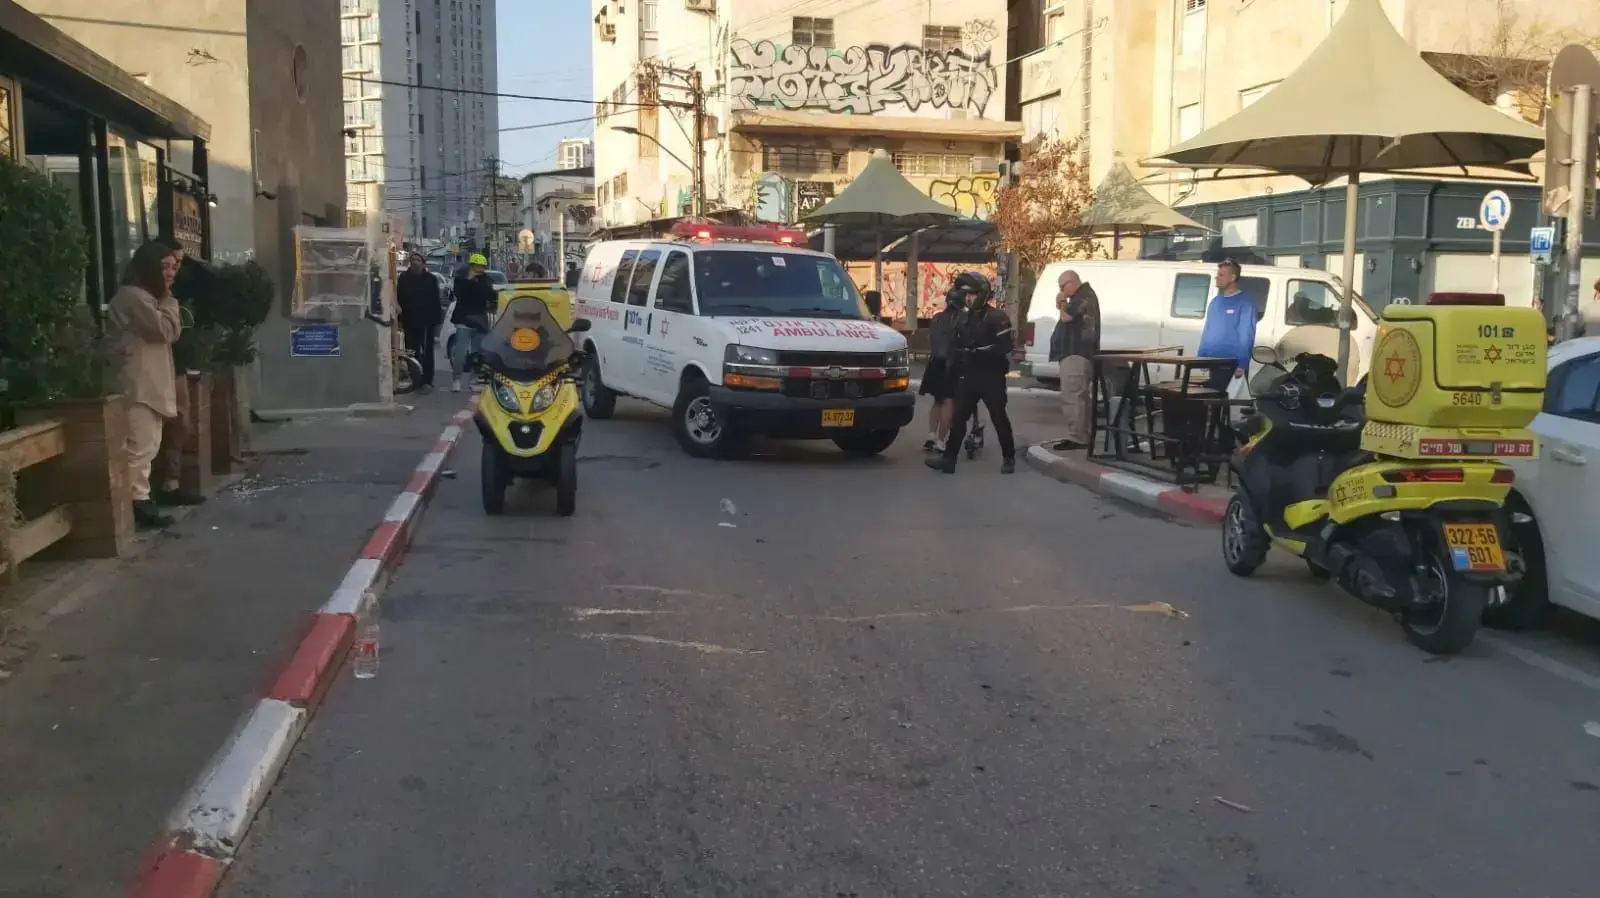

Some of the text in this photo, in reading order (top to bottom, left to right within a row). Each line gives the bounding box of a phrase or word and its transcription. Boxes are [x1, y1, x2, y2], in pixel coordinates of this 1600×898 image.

[736, 325, 763, 334] 1241
[773, 327, 881, 340] AMBULANCE
[1478, 325, 1498, 338] 101
[1452, 392, 1482, 406] 5640
[1421, 443, 1444, 453] חיים
[1447, 442, 1462, 454] של
[1494, 443, 1516, 453] עניין
[1519, 443, 1531, 453] זה
[1448, 527, 1497, 545] 322-56
[1468, 546, 1493, 563] 601
